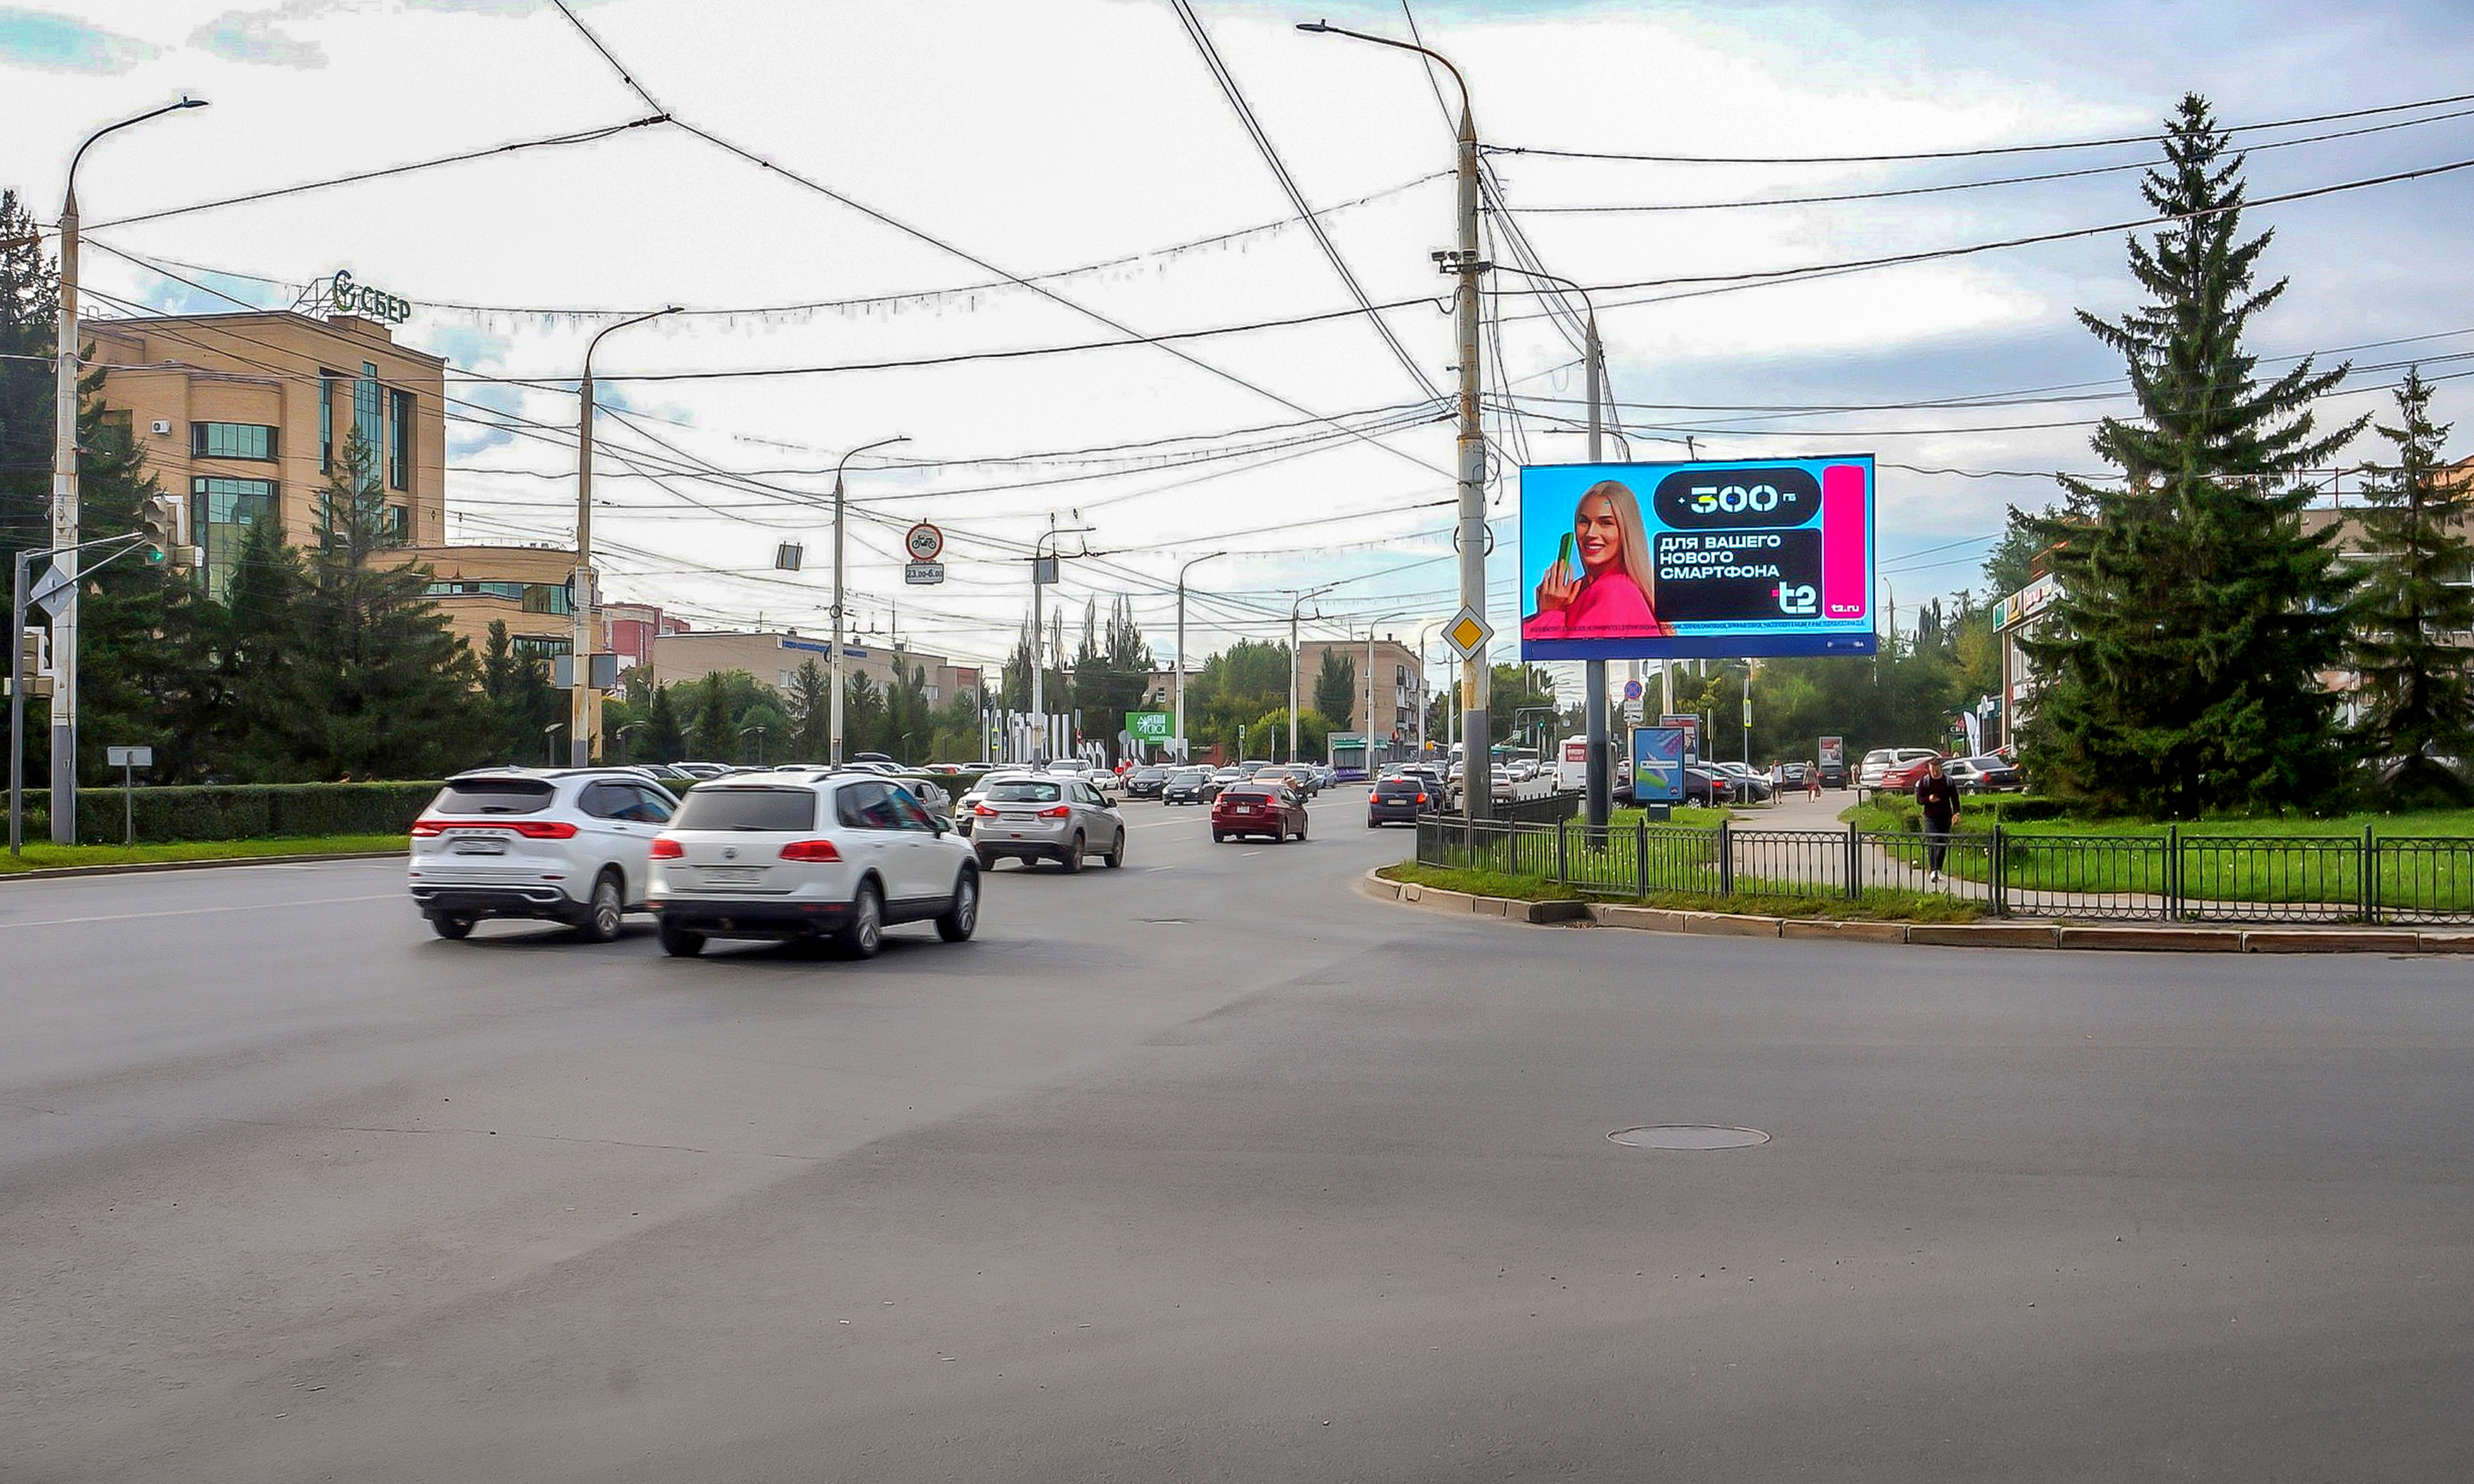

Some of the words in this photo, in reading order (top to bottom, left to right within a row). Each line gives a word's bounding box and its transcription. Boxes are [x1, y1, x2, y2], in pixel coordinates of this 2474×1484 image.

[360, 285, 411, 324] СБЕР
[1691, 484, 1778, 514] 300
[1660, 537, 1699, 551] ДЛЯ
[1705, 535, 1781, 549] ВАШЕГО
[1660, 550, 1734, 565] НОВОГО
[1660, 565, 1781, 579] СМАРТФОНА
[1771, 581, 1817, 614] t2
[1830, 603, 1860, 613] t2.ru
